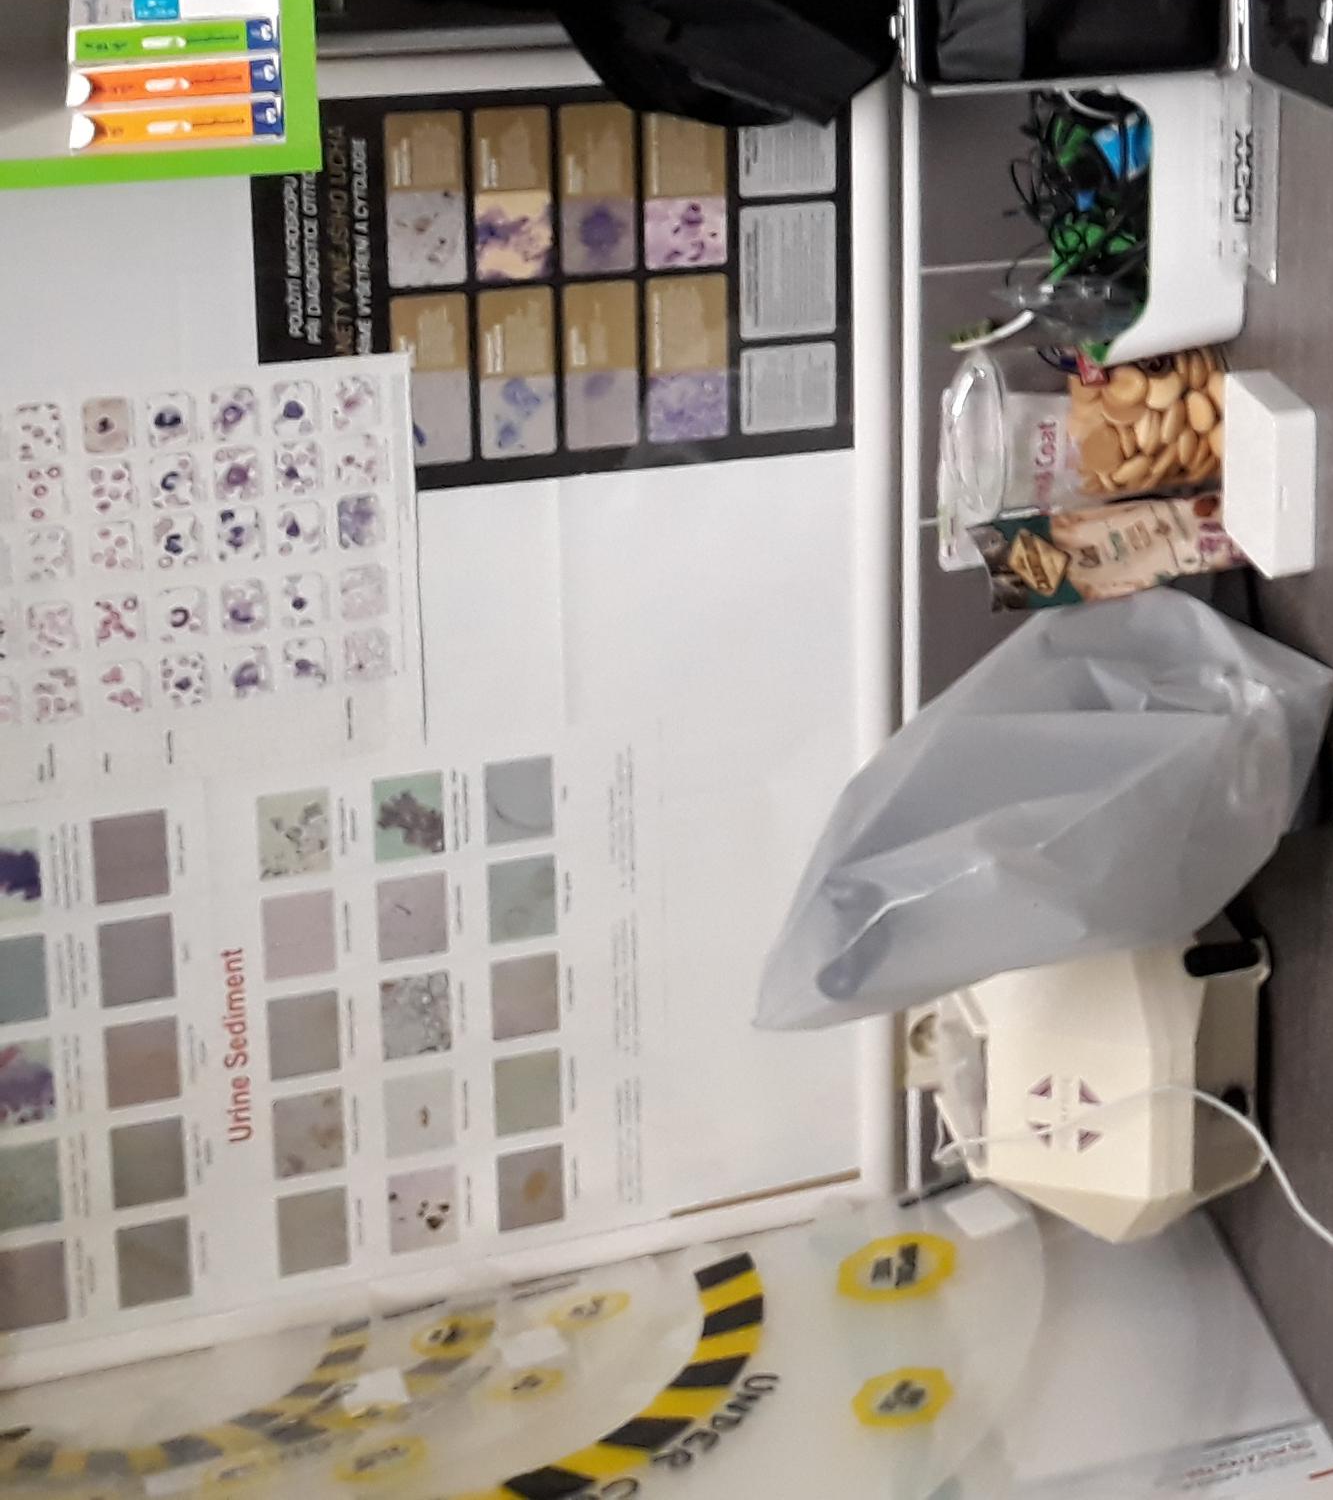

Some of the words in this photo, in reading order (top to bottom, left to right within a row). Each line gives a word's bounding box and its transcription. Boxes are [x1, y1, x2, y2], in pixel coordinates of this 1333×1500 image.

[1234, 128, 1253, 223] IDEXX
[282, 175, 301, 277] MIKROSKOPU
[1034, 421, 1056, 468] Coat
[221, 948, 248, 1069] Sediment
[226, 1076, 252, 1143] Urine
[652, 1373, 780, 1470] UNDER
